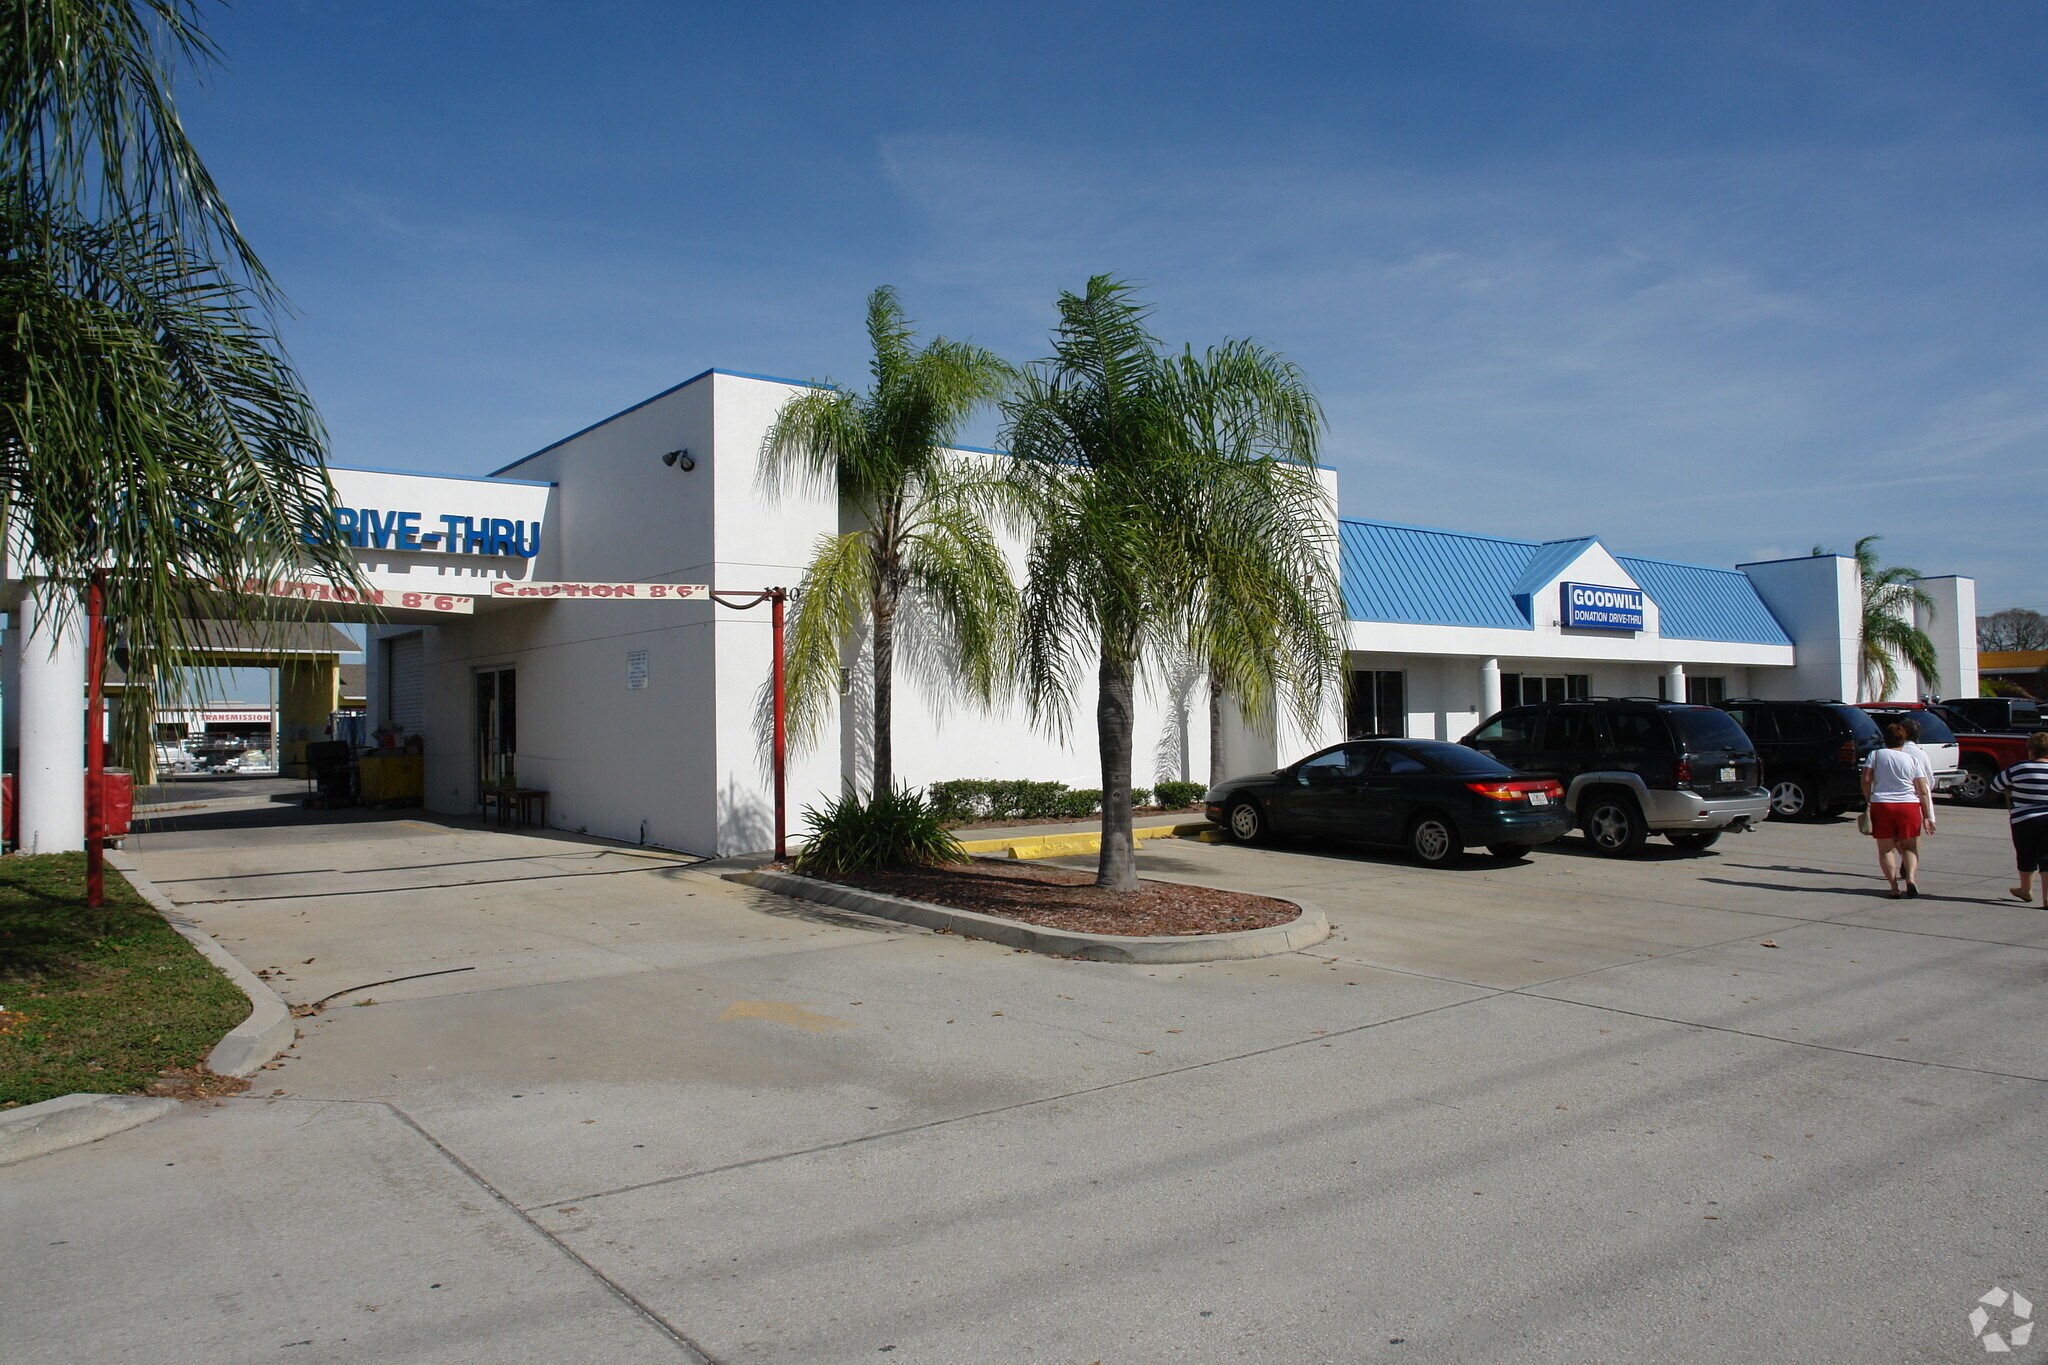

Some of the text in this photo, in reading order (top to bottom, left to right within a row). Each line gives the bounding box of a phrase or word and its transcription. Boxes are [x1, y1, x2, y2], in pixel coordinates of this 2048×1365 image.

[1573, 589, 1642, 610] GOODWILL
[1574, 610, 1642, 625] DONATION DRIVE-THRU
